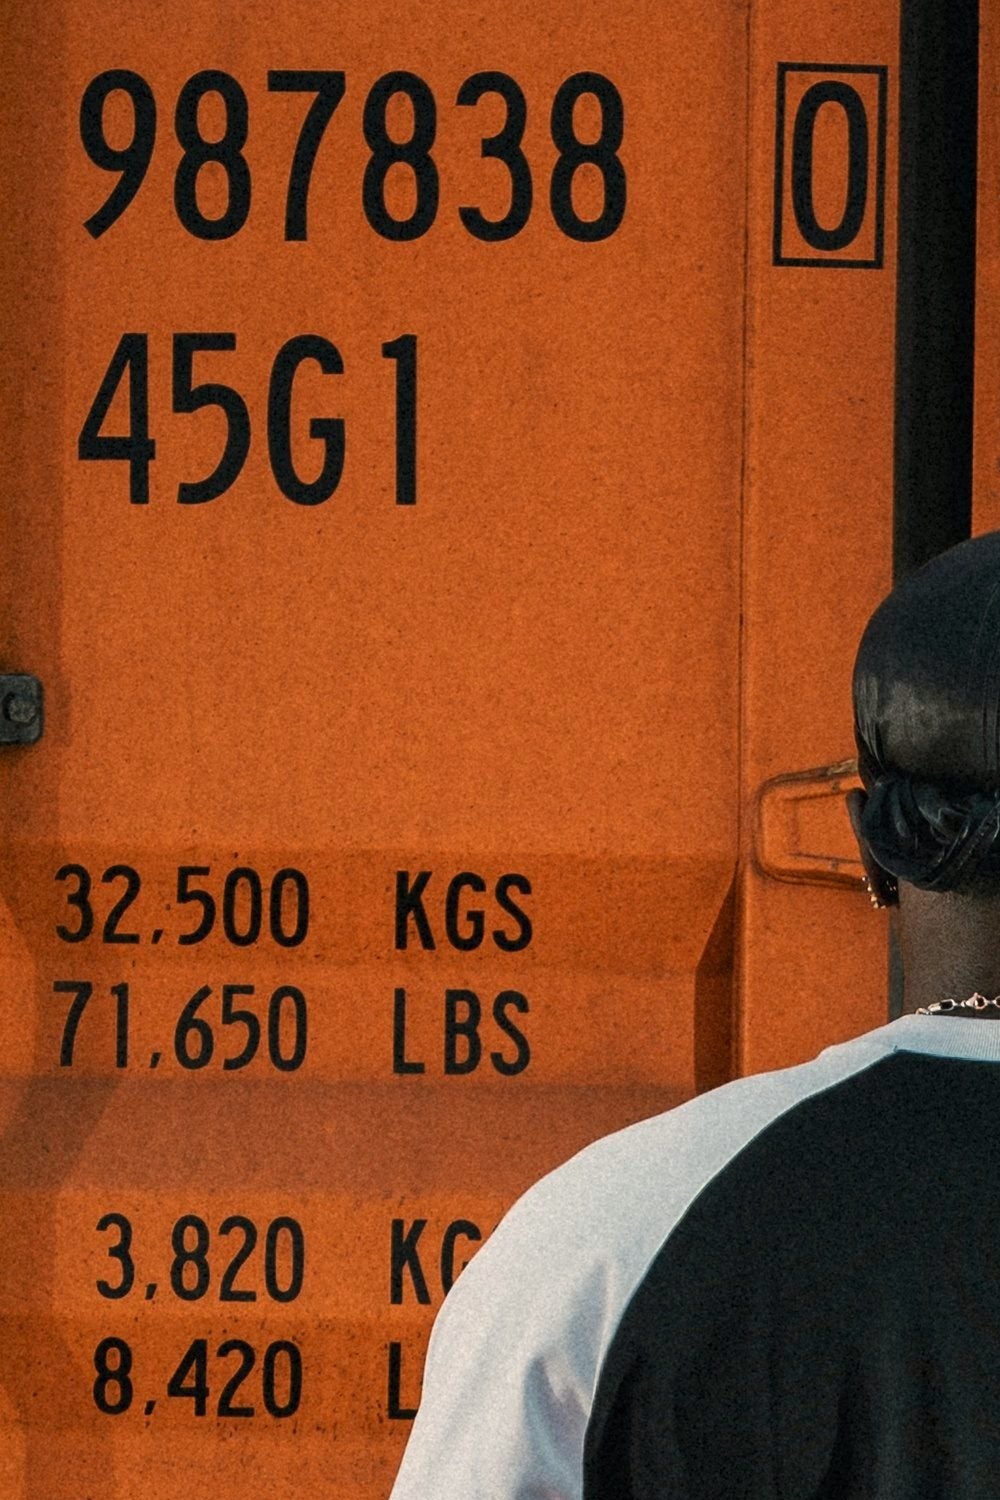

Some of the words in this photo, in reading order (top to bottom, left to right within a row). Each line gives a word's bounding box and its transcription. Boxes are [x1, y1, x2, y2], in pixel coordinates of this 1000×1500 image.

[80, 69, 626, 242] 987838
[792, 81, 869, 251] 0
[79, 333, 416, 505] 45G1
[55, 864, 309, 947] 32,500
[396, 871, 532, 952] KGS
[53, 981, 307, 1071] 71,650
[394, 989, 530, 1076] LBS
[97, 1214, 304, 1302] 3,820
[391, 1219, 498, 1305] KG
[93, 1337, 302, 1418] 8,420
